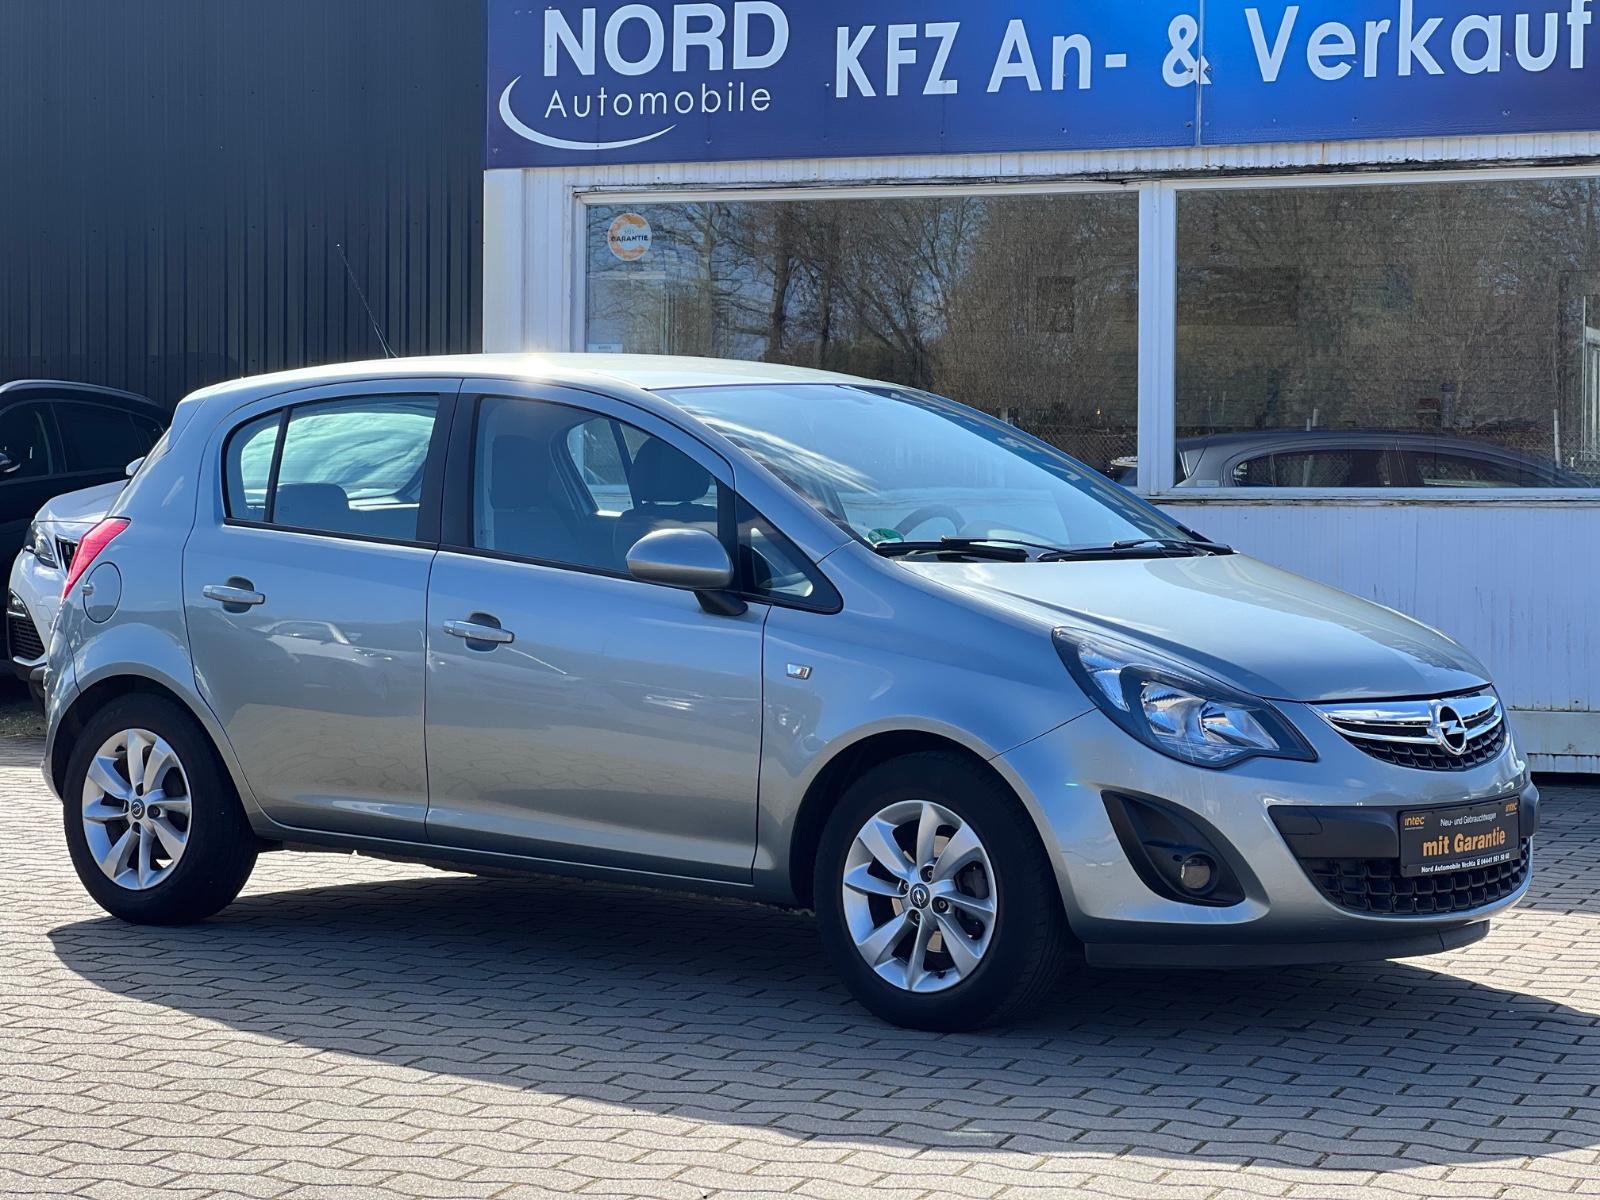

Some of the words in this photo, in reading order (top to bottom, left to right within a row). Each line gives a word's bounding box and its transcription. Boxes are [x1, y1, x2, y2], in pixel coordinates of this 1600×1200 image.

[543, 1, 790, 77] NORD
[835, 21, 961, 98] KFZ
[987, 18, 1128, 92] An-
[1161, 13, 1213, 89] &
[1244, 0, 1593, 83] Verkauf
[544, 82, 771, 119] Automobile
[610, 234, 649, 242] GARANTIE
[1404, 815, 1425, 826] intec
[1440, 818, 1453, 827] Neu-
[1454, 816, 1463, 826] und
[1423, 835, 1449, 857] mit
[1454, 826, 1506, 853] Garantie
[1421, 865, 1434, 874] Nord
[1434, 862, 1461, 872] Automobile
